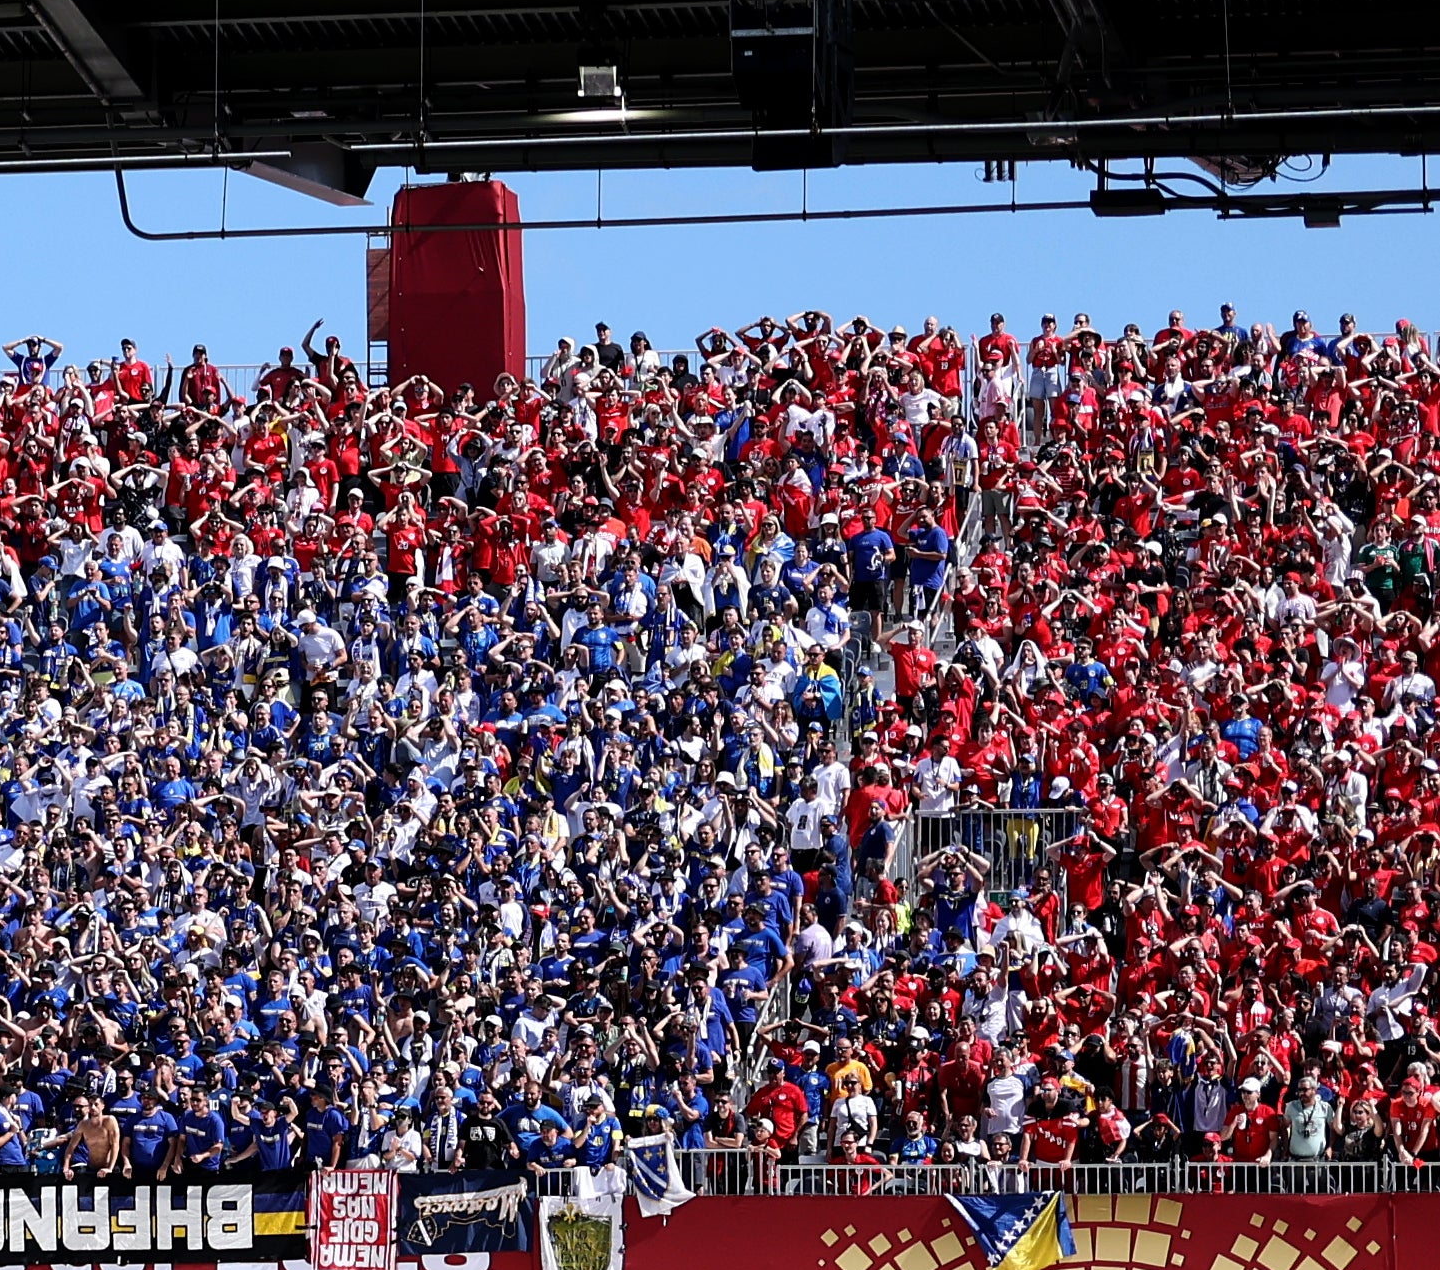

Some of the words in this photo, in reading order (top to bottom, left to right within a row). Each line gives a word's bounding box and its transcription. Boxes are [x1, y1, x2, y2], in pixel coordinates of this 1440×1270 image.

[322, 1172, 388, 1195] NEMA
[333, 1196, 376, 1219] NAS
[329, 1219, 379, 1243] GDJE
[320, 1245, 386, 1268] NEMA
